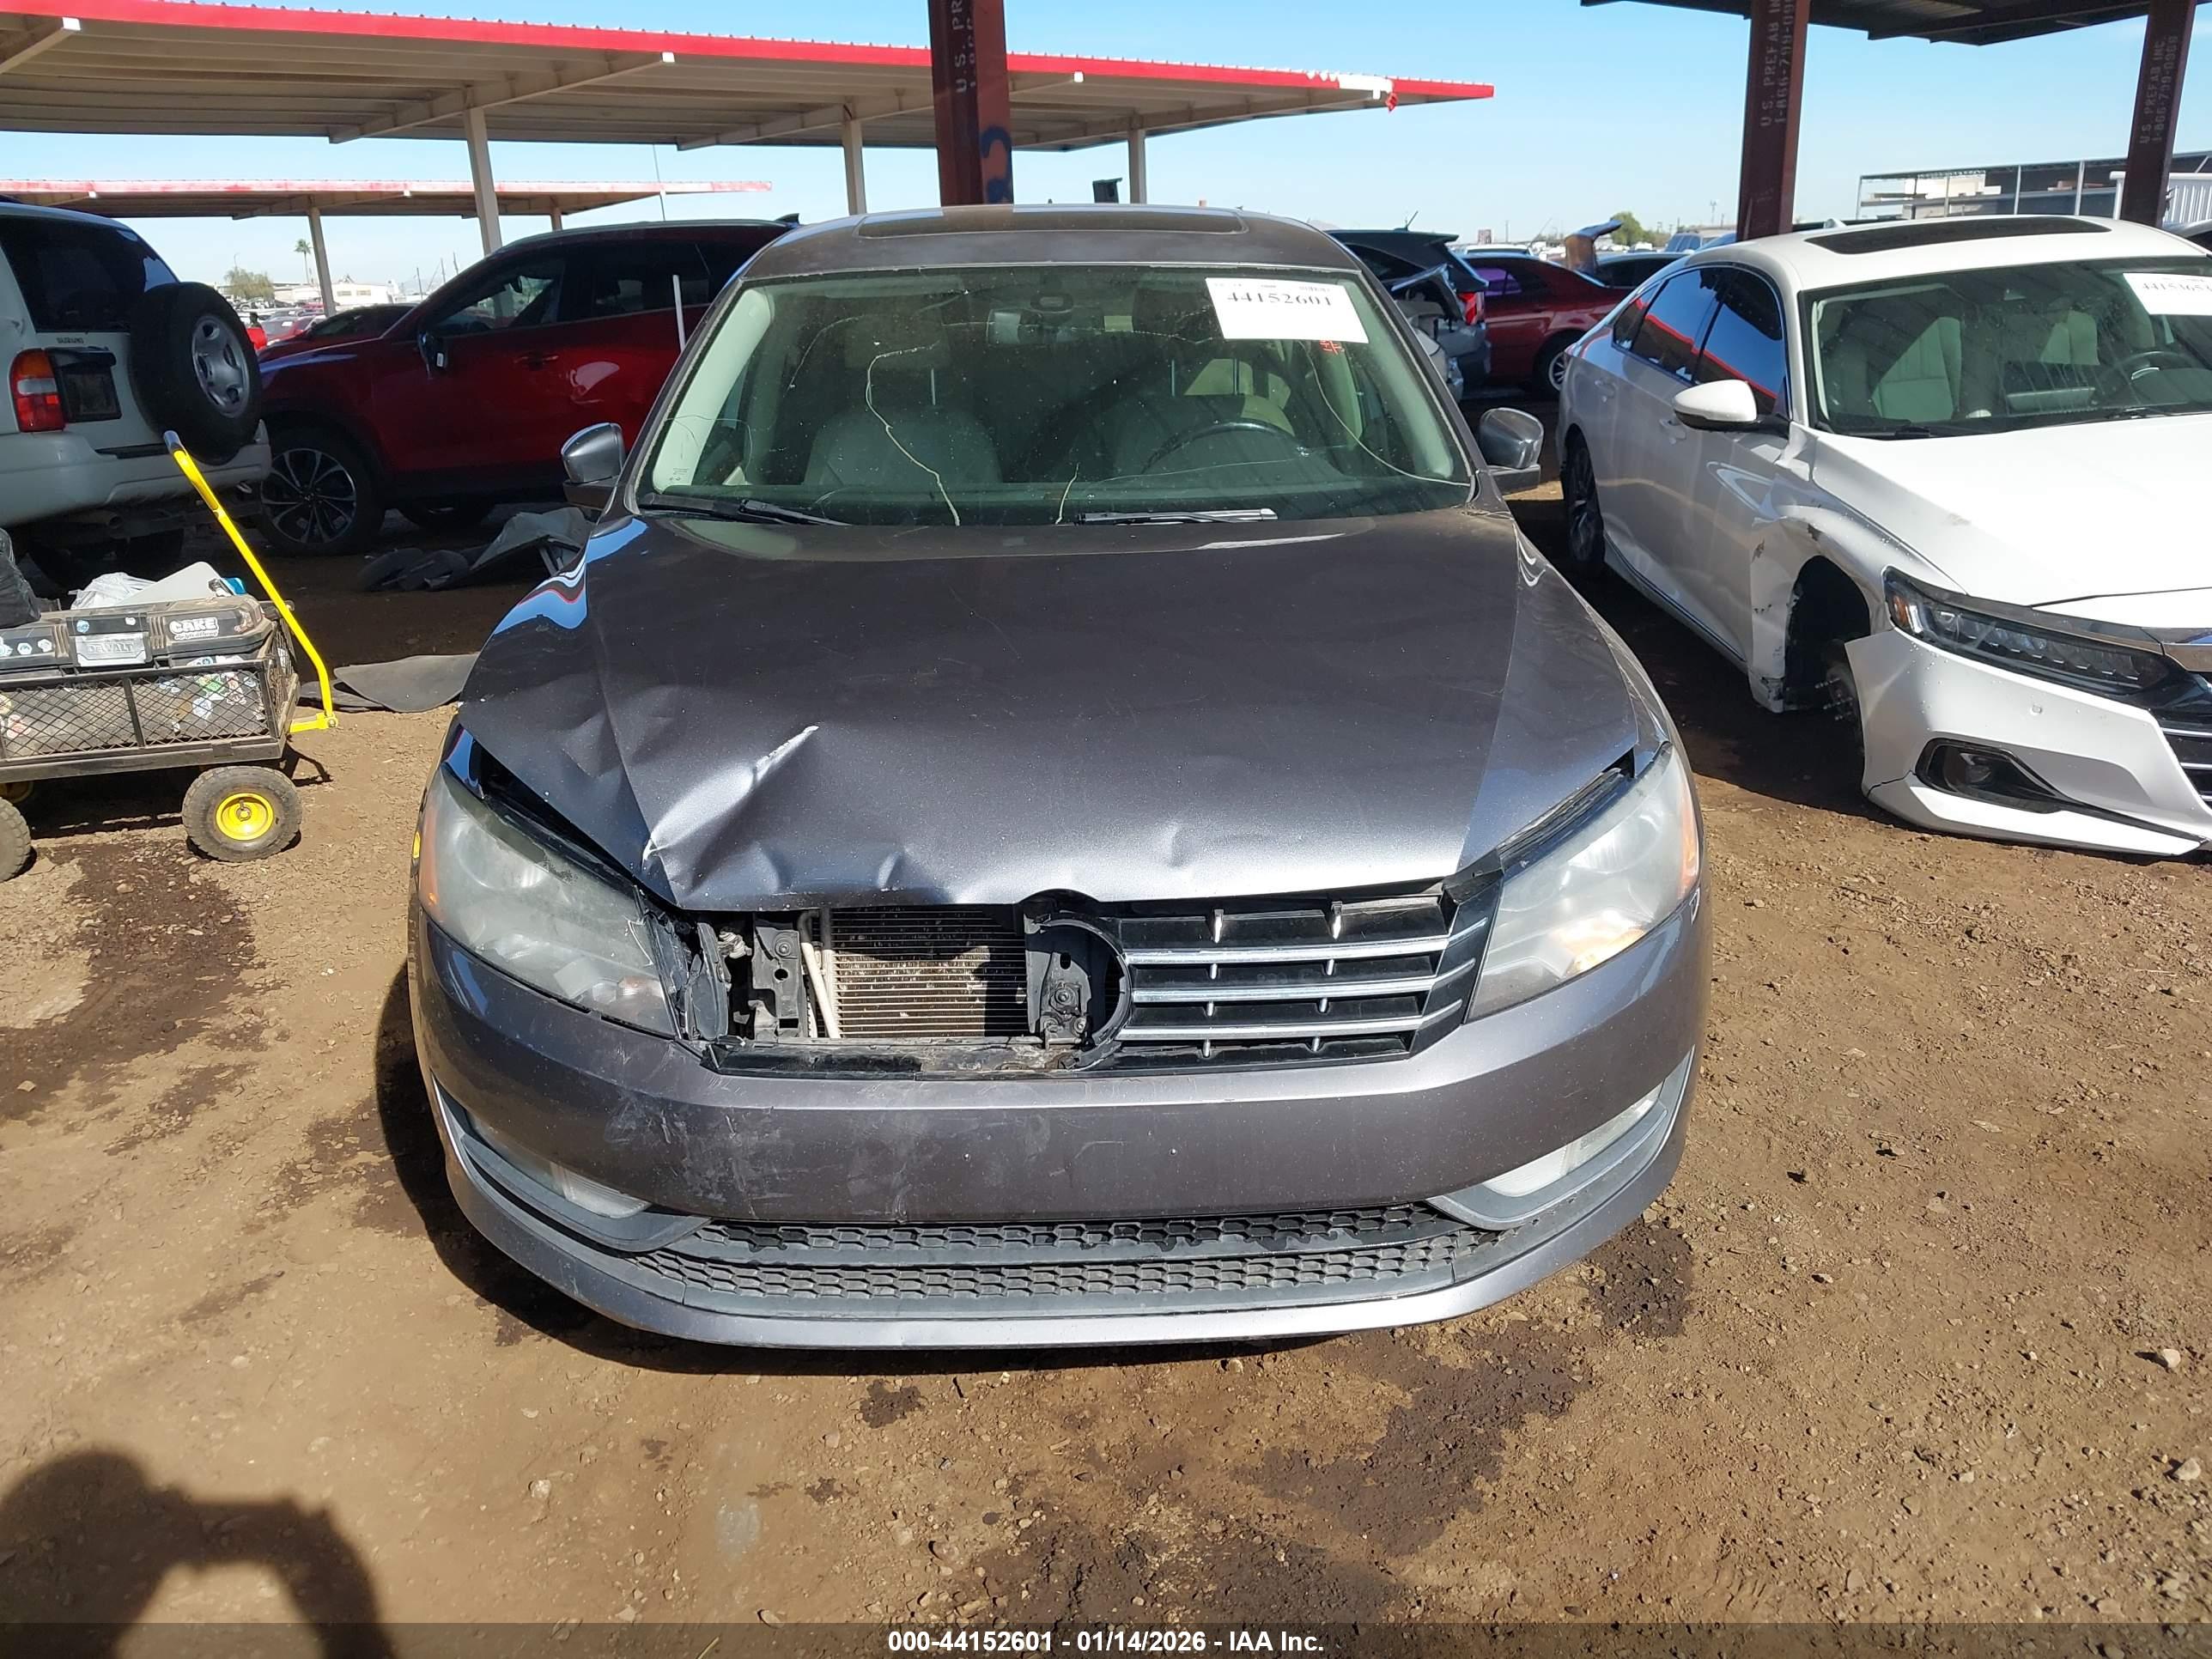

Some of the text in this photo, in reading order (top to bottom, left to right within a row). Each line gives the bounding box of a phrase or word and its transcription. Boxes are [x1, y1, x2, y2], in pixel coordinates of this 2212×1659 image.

[954, 45, 968, 93] U.S.
[1763, 21, 1780, 86] PREFAB
[2143, 65, 2162, 114] PREFAB
[1227, 291, 1333, 307] 44152601
[170, 618, 216, 634] CAKE
